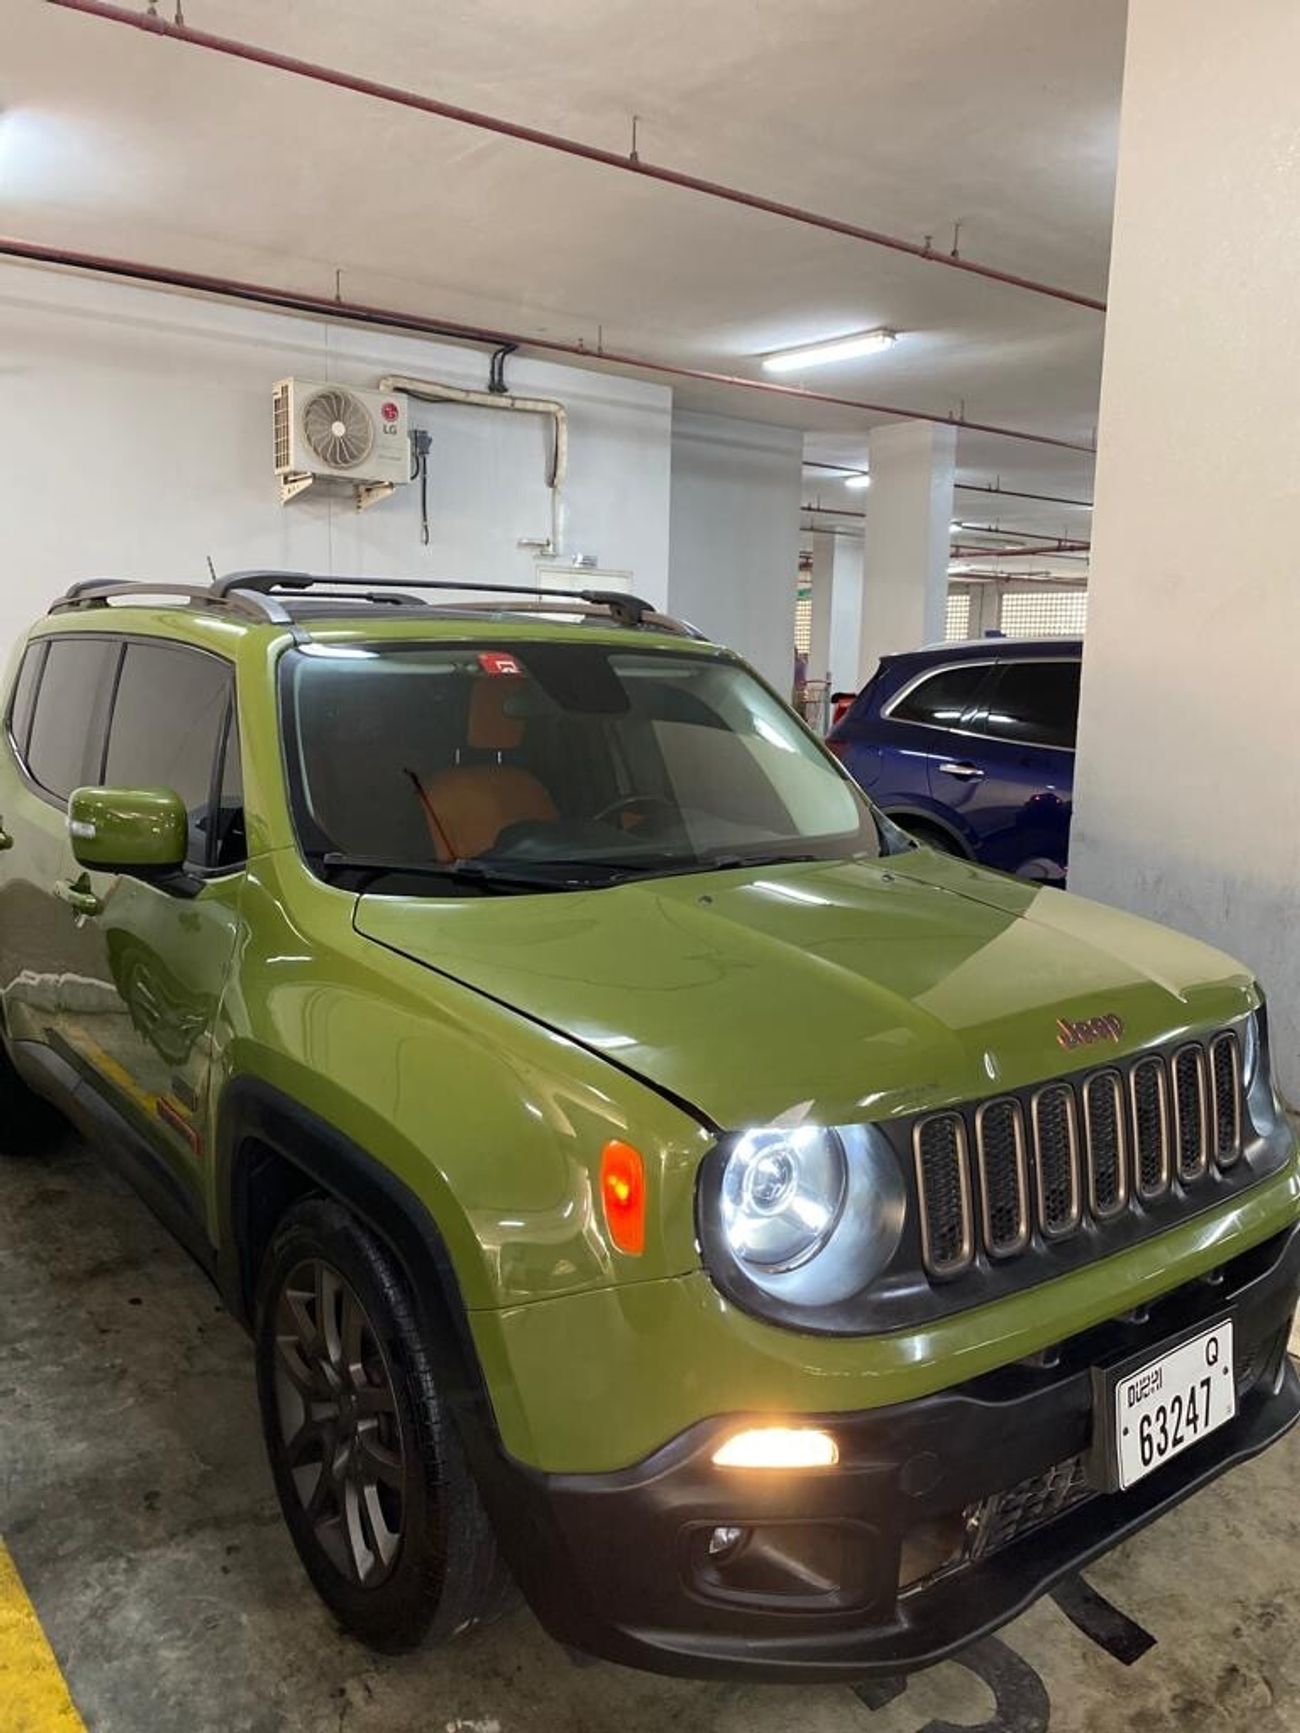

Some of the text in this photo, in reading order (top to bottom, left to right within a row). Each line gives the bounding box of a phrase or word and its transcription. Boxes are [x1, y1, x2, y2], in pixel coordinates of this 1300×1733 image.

[383, 424, 398, 435] LG
[1056, 1014, 1122, 1052] Jeep
[1205, 1337, 1219, 1367] Q
[1139, 1376, 1212, 1467] 63247
